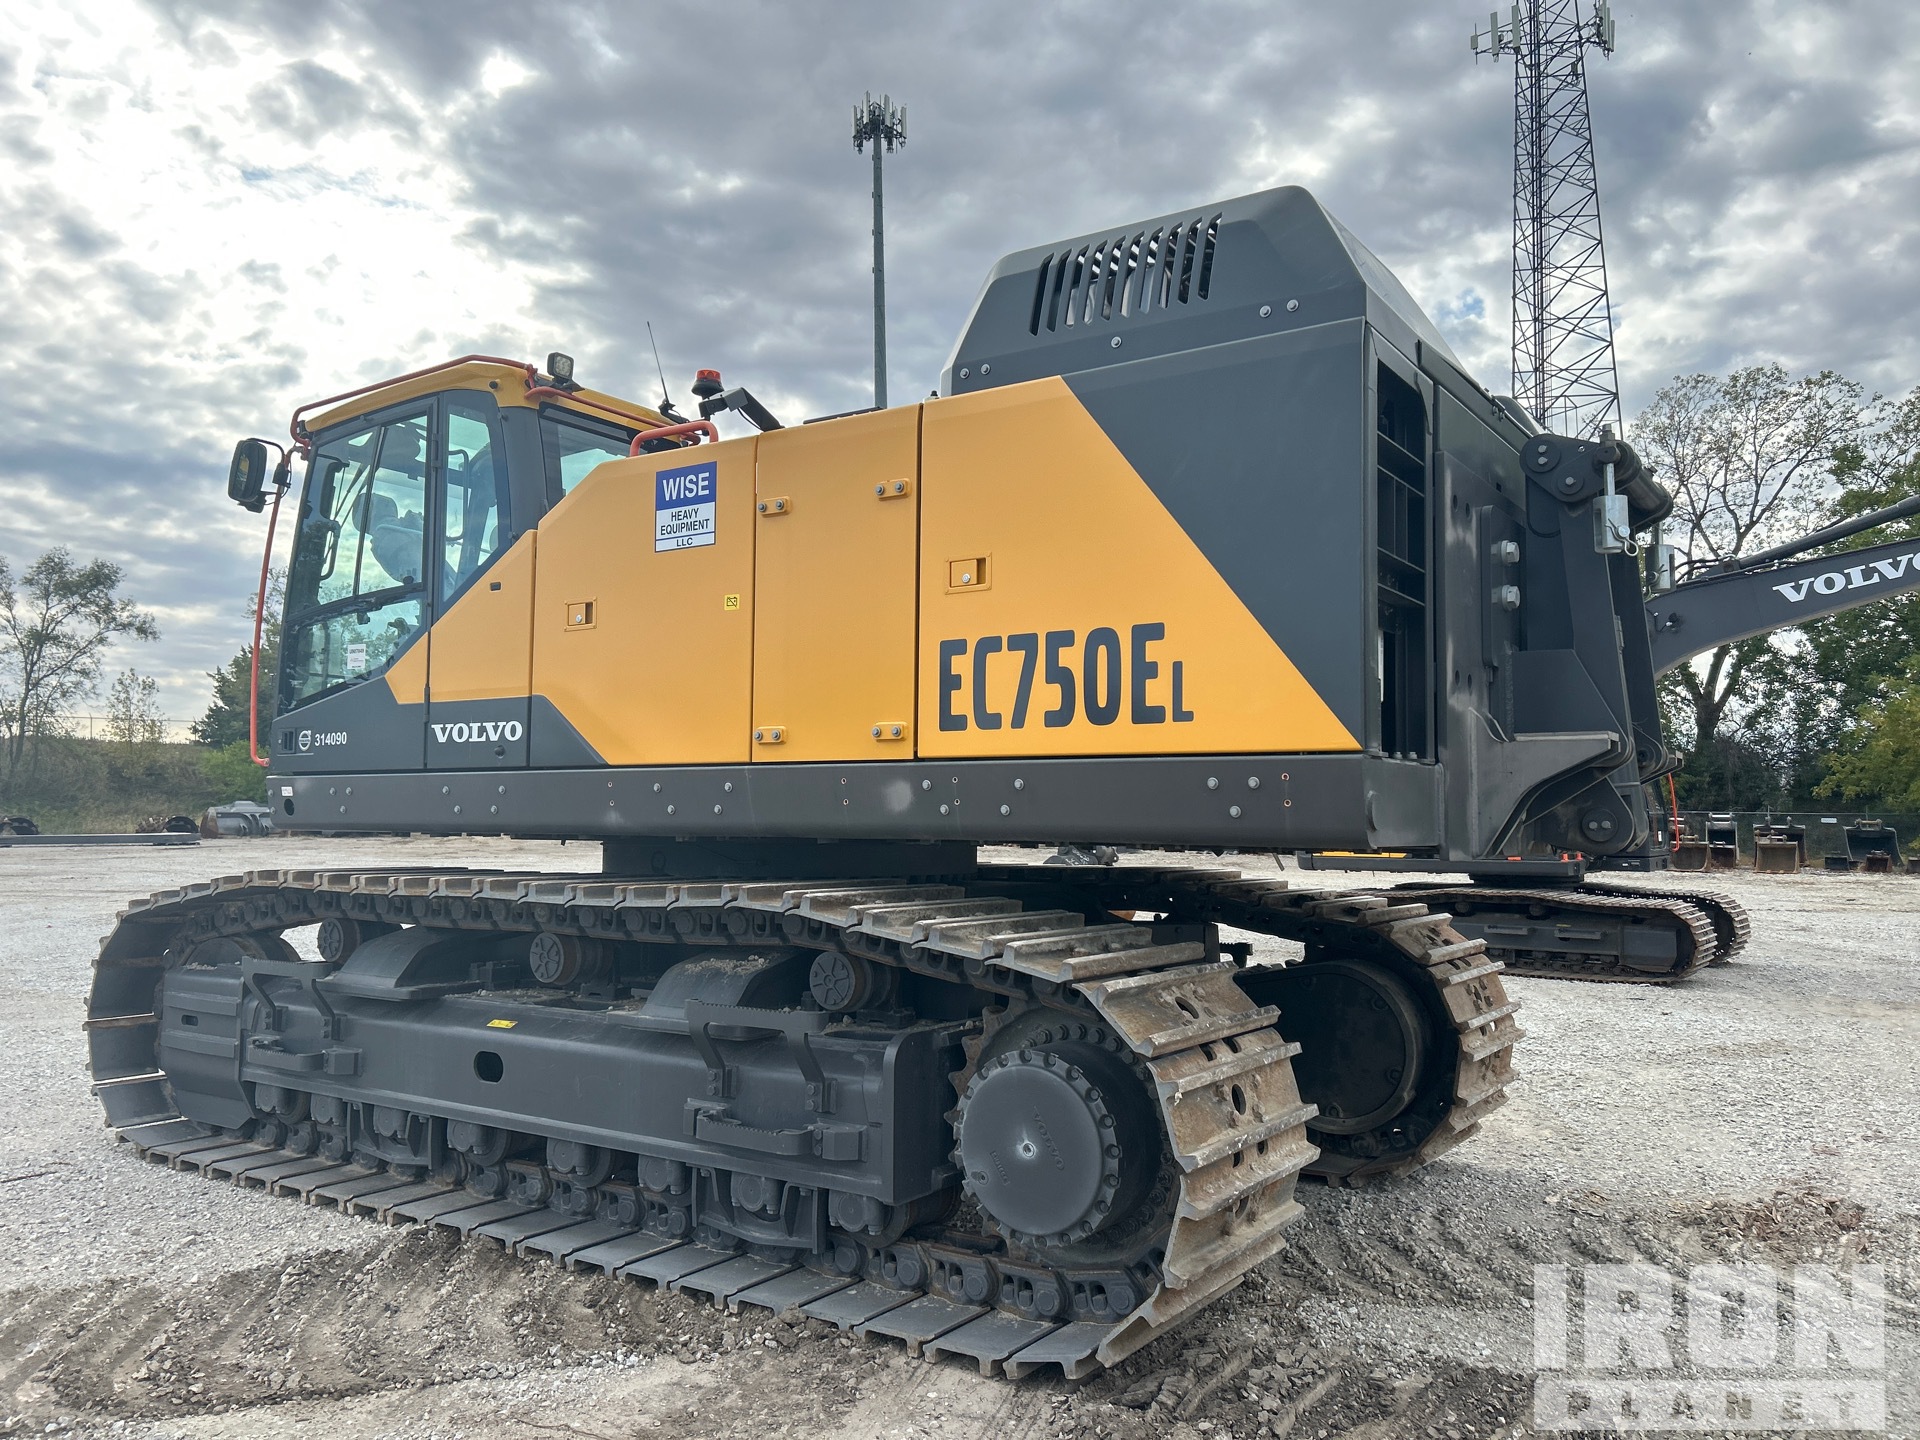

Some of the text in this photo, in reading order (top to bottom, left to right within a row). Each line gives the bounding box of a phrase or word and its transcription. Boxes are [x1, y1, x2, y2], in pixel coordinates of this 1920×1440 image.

[662, 472, 710, 501] WISE
[671, 507, 699, 522] HEAVY
[660, 518, 710, 536] EQUIPMENT
[676, 537, 693, 547] LLC
[1772, 552, 1920, 603] VOLV
[314, 731, 347, 747] 314090
[431, 720, 523, 743] VOLVO
[1032, 1105, 1066, 1171] VOLVO
